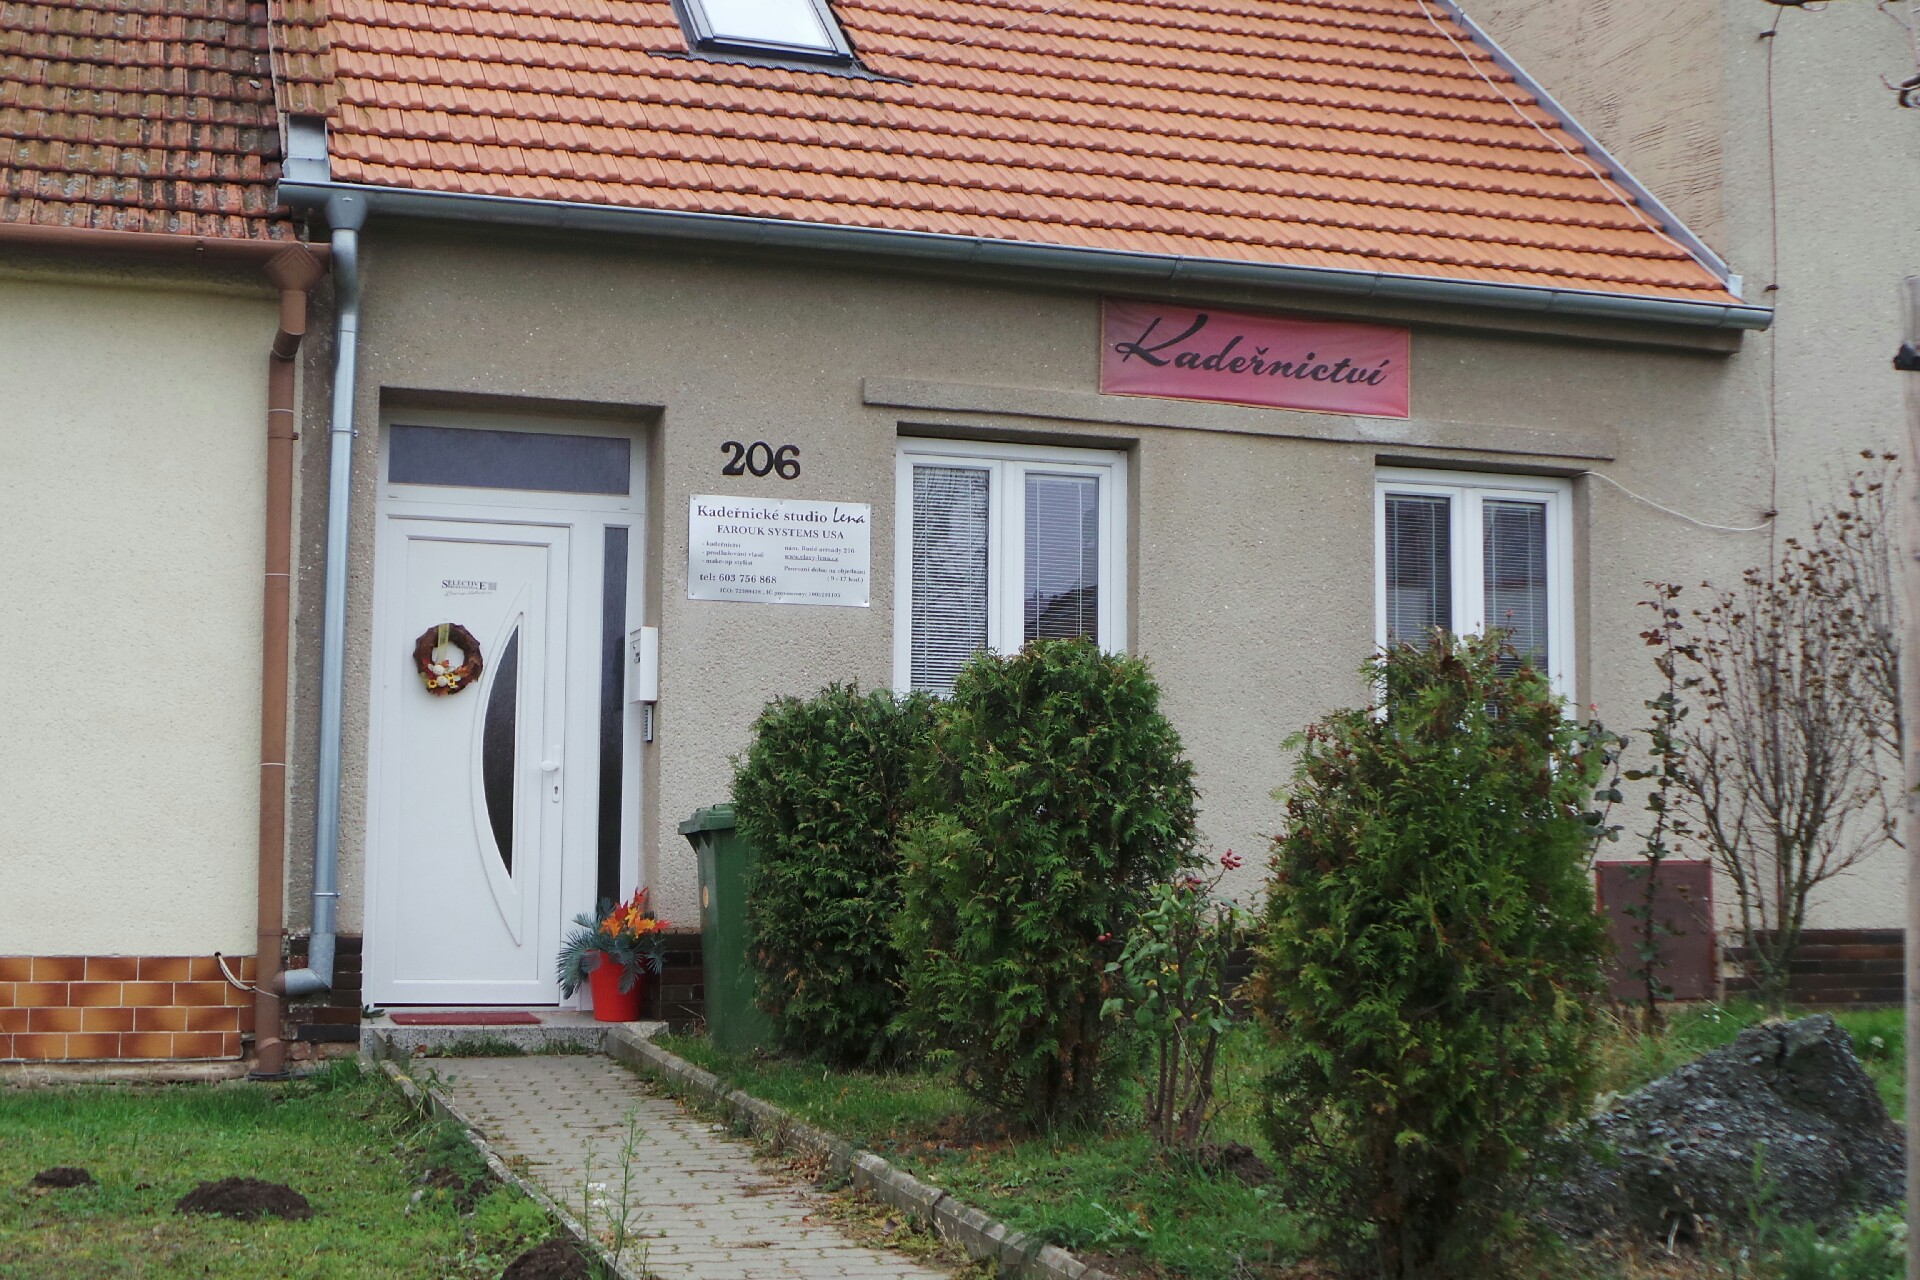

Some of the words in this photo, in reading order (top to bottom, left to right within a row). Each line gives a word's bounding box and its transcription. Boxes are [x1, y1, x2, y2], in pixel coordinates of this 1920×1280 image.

[1114, 314, 1391, 386] Kadeřnictví
[720, 440, 800, 480] 206
[697, 504, 779, 521] Kadeřnické
[783, 510, 828, 523] studio
[717, 524, 765, 536] FAROUK
[767, 527, 819, 539] SYSTEMS
[822, 529, 845, 540] USA
[699, 573, 716, 581] tel:
[718, 573, 736, 582] 603
[739, 574, 757, 584] 756
[759, 575, 777, 584] 868
